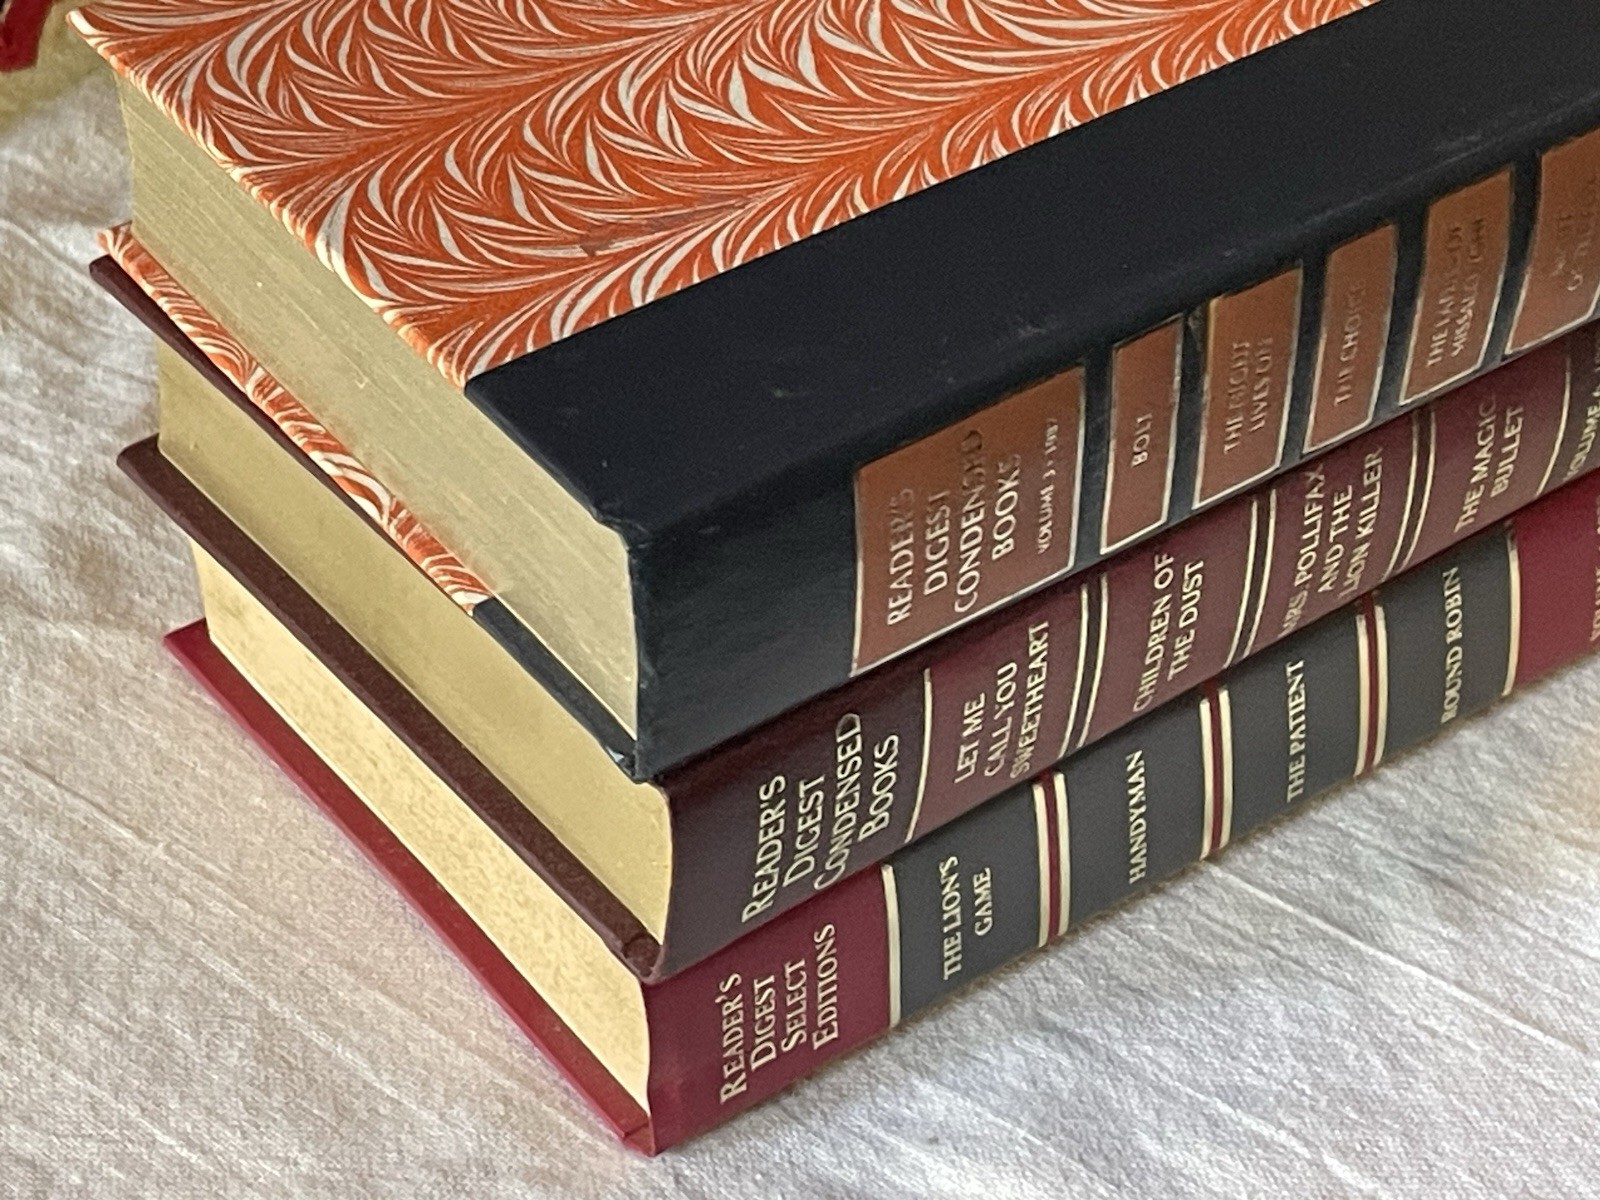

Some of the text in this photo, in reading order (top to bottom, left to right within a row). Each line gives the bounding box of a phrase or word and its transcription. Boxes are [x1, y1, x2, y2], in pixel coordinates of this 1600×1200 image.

[991, 453, 1022, 560] BOOKS
[1356, 446, 1383, 541] KILLER
[1455, 394, 1497, 531] THE MAGIC
[1490, 406, 1525, 498] BULLET
[887, 489, 915, 625] READER'S
[923, 490, 950, 595] DIGEST
[954, 430, 985, 612] CONDENSED
[1295, 463, 1327, 586] POLLIFAX
[1318, 484, 1352, 593] AND THE
[1133, 553, 1174, 712] CHILDREN OF
[1167, 560, 1204, 681] THE DUST
[1441, 567, 1464, 723] ROUND ROBIN
[954, 692, 985, 784] LET ME
[984, 662, 1018, 776] CALL YOU
[1010, 620, 1049, 779] SWEETHEART
[1286, 660, 1306, 802] THE PATIENT
[742, 775, 786, 922] READER'S
[783, 774, 825, 887] DIGEST
[813, 712, 862, 890] CONDENSED
[858, 734, 899, 841] BOOKS
[1126, 750, 1146, 885] HANDYMAN
[939, 856, 962, 980] THE LION'S
[973, 867, 993, 936] GAME
[715, 973, 747, 1104] READER'S
[751, 974, 777, 1072] DIGEST
[781, 959, 808, 1052] SELECT
[812, 923, 839, 1050] EDITIONS
